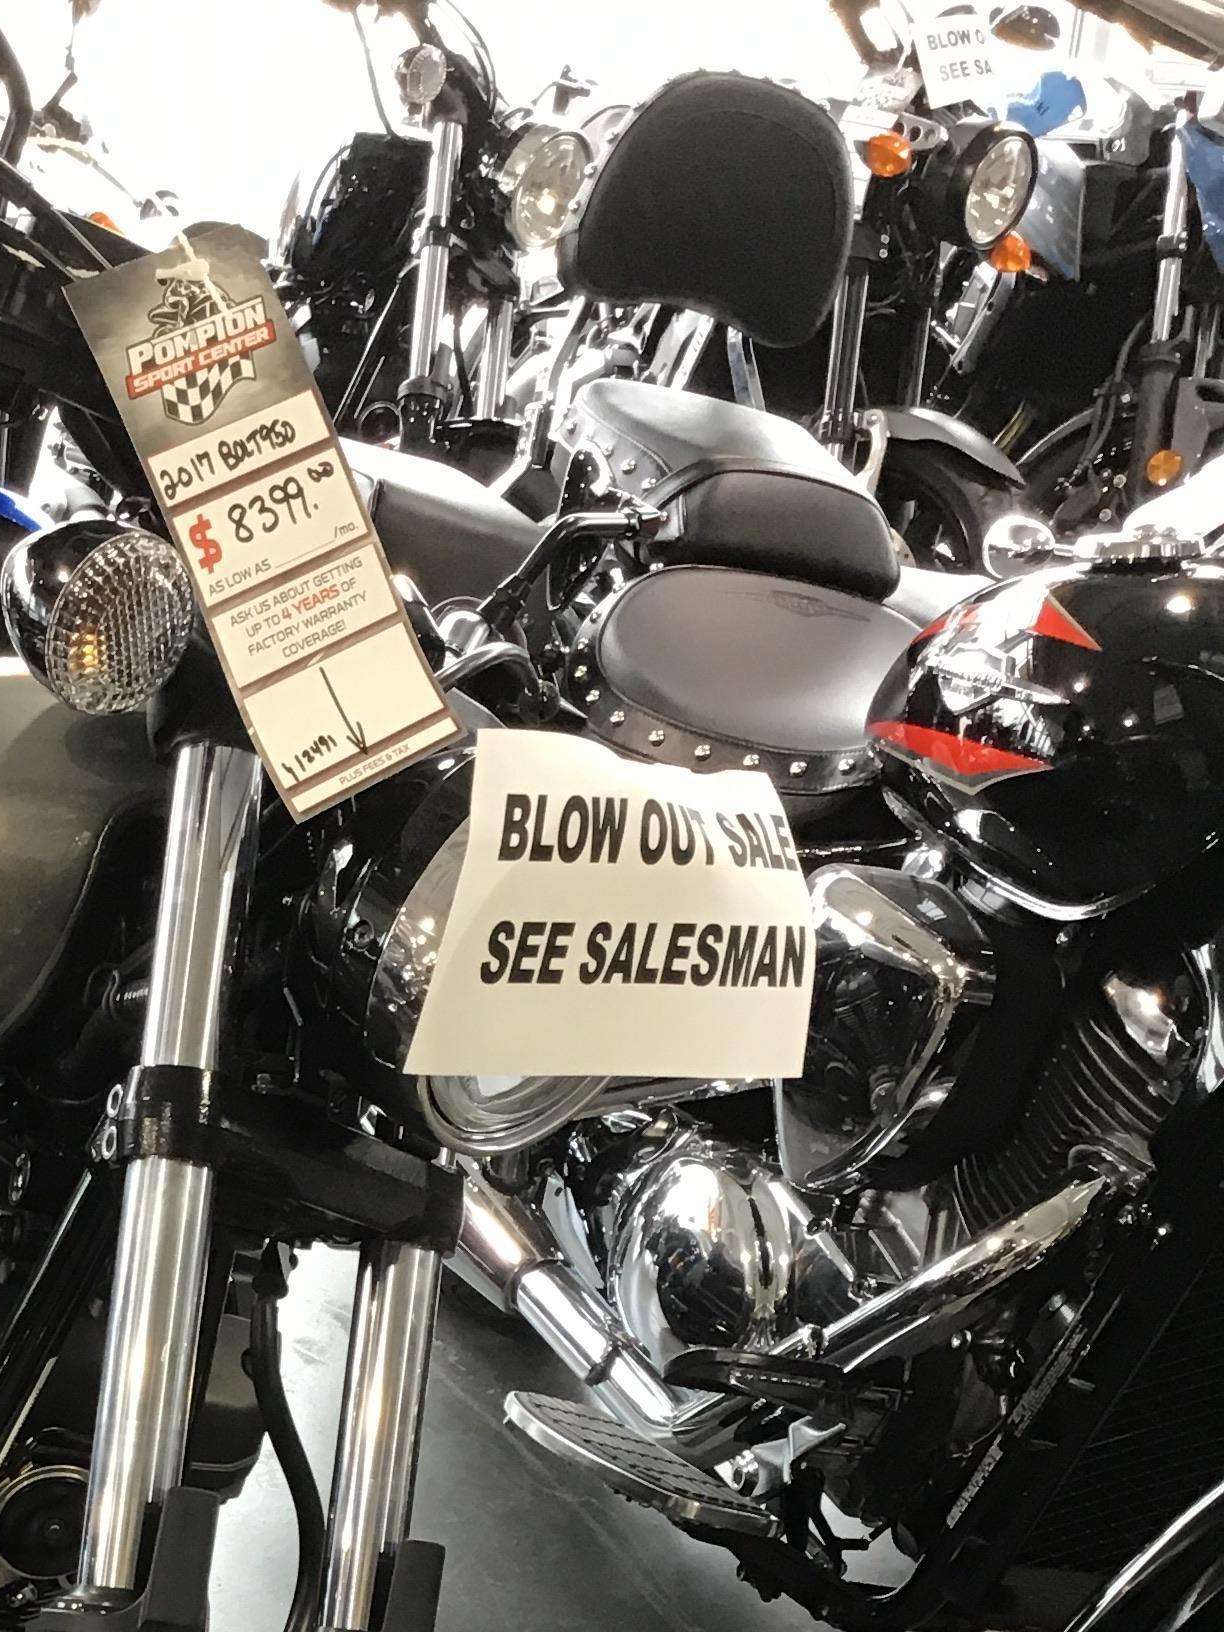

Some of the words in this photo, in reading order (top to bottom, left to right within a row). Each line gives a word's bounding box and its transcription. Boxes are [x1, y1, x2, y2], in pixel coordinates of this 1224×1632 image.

[927, 30, 971, 50] BLOW
[939, 60, 970, 81] SEE
[127, 297, 266, 376] POMPTON
[133, 355, 195, 393] SPORT
[198, 327, 270, 366] CENTER
[160, 450, 216, 500] 2017
[208, 580, 225, 597] AS
[226, 567, 252, 588] LOW
[254, 558, 272, 576] AS
[230, 607, 254, 627] ASK
[255, 599, 271, 616] US
[273, 580, 311, 607] ABOUT
[312, 556, 364, 588] GETTING
[245, 623, 263, 638] UP
[263, 614, 281, 630] TO
[281, 607, 293, 621] 4
[292, 584, 341, 616] YEARS
[340, 577, 357, 593] OF
[248, 622, 302, 657] FACTORY
[302, 590, 369, 629] WARRANTY
[339, 769, 364, 786] PLUS
[393, 743, 411, 758] TAX
[498, 793, 628, 864] BLOW
[640, 799, 715, 866] OUT
[715, 811, 800, 872] SALE
[480, 920, 575, 985] SEE
[579, 920, 807, 988] SALESMAN
